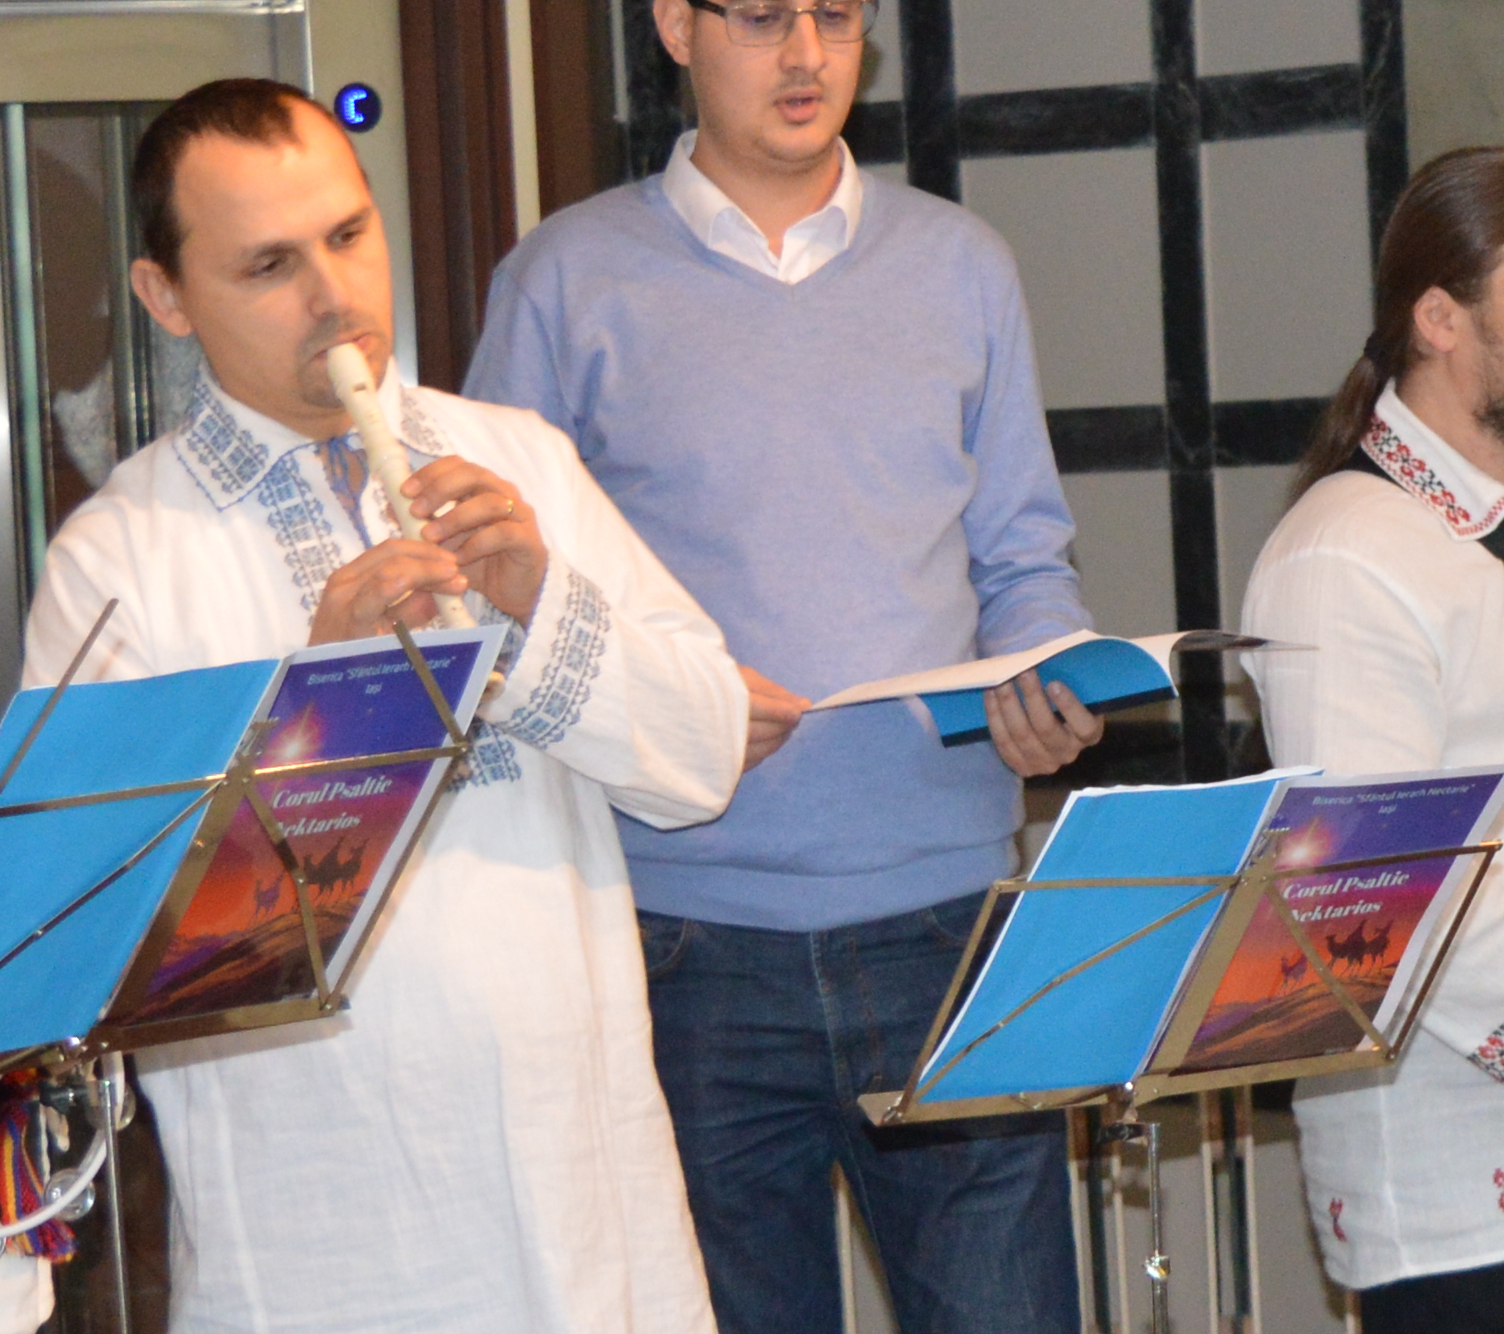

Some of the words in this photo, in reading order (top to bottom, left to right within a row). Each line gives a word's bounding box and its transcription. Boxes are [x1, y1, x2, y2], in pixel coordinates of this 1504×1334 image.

[272, 783, 330, 808] Corul
[329, 775, 392, 801] Psaltic
[1283, 878, 1343, 899] Corul
[1343, 870, 1410, 893] Psaltic
